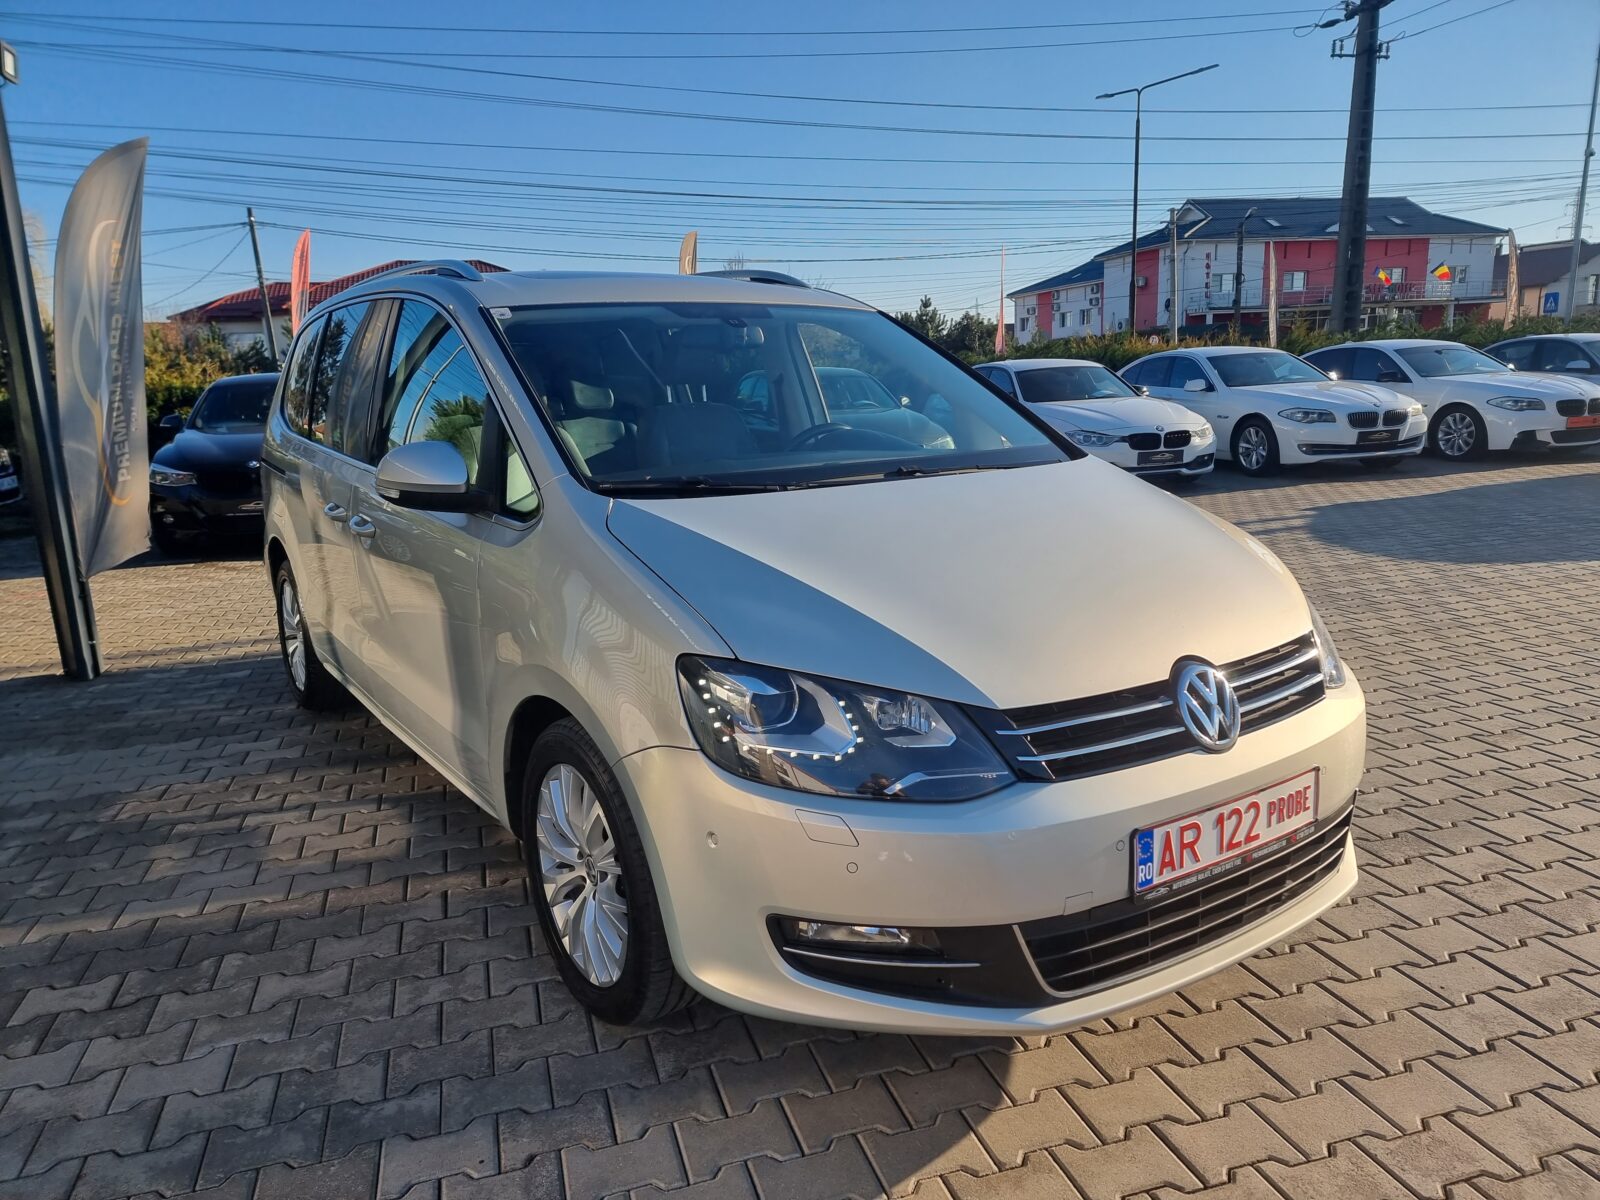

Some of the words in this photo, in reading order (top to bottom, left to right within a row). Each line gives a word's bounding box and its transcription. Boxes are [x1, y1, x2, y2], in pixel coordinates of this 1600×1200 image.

[1158, 820, 1203, 877] AR
[1215, 800, 1262, 855] 122
[1267, 784, 1312, 829] PROBE
[1138, 862, 1154, 884] RO
